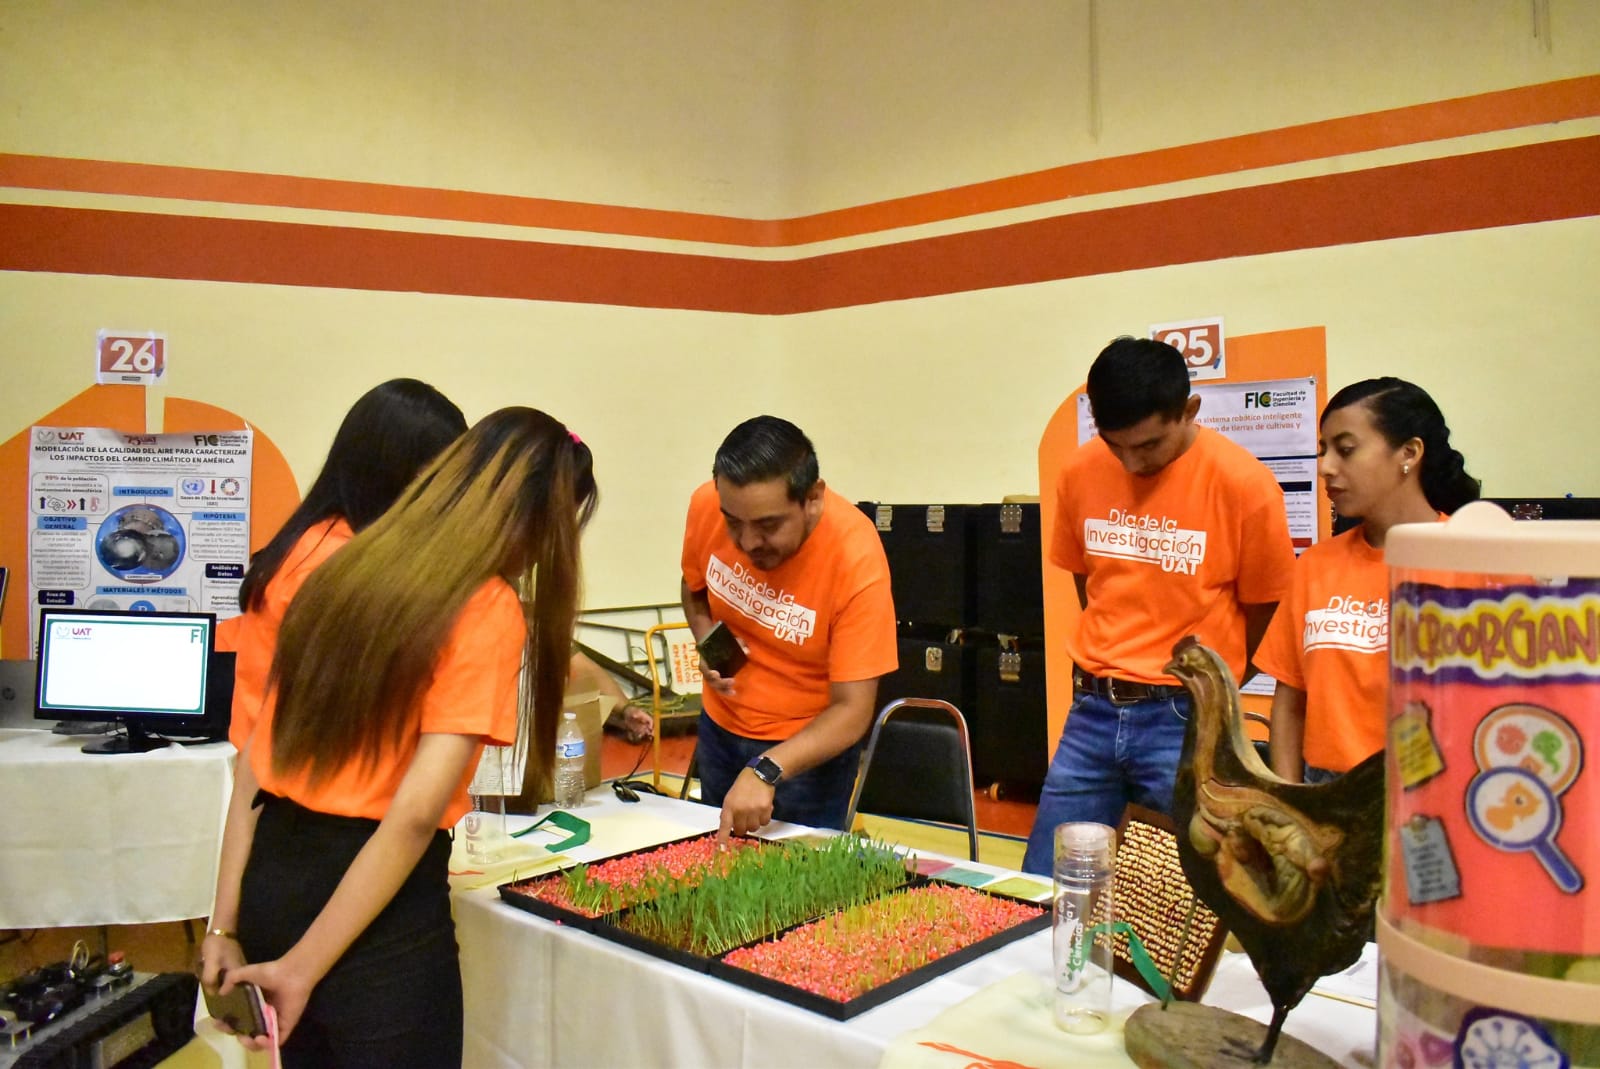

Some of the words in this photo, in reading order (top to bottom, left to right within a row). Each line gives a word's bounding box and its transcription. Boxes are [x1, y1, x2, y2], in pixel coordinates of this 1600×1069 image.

[110, 339, 156, 372] 26
[1164, 328, 1213, 366] 25
[1245, 391, 1272, 409] FIC
[1231, 424, 1254, 432] tierras
[1266, 421, 1294, 430] cultivos
[1232, 413, 1261, 422] robótico
[1263, 412, 1303, 421] inteligente
[58, 431, 85, 441] UAT
[194, 434, 219, 446] FIC
[35, 445, 85, 453] MODELACIÓN
[66, 454, 105, 462] IMPACTOS
[152, 455, 191, 463] CLIMÁTICO
[202, 456, 235, 464] AMÉRICA
[119, 487, 169, 495] INTRODUCCIÓN
[1108, 508, 1137, 529] Día
[1137, 514, 1159, 531] de
[1160, 516, 1177, 533] la
[1086, 525, 1202, 556] Investigación
[1161, 555, 1200, 576] UAT
[732, 561, 756, 589] Día
[755, 582, 776, 601] de
[776, 589, 795, 607] la
[708, 562, 810, 632] Investigación
[1325, 595, 1366, 617] Día
[1366, 598, 1389, 619] de
[72, 627, 92, 636] UAT
[774, 623, 808, 647] UAT
[1305, 619, 1389, 644] nvestiga
[1072, 922, 1083, 967] Ciencias
